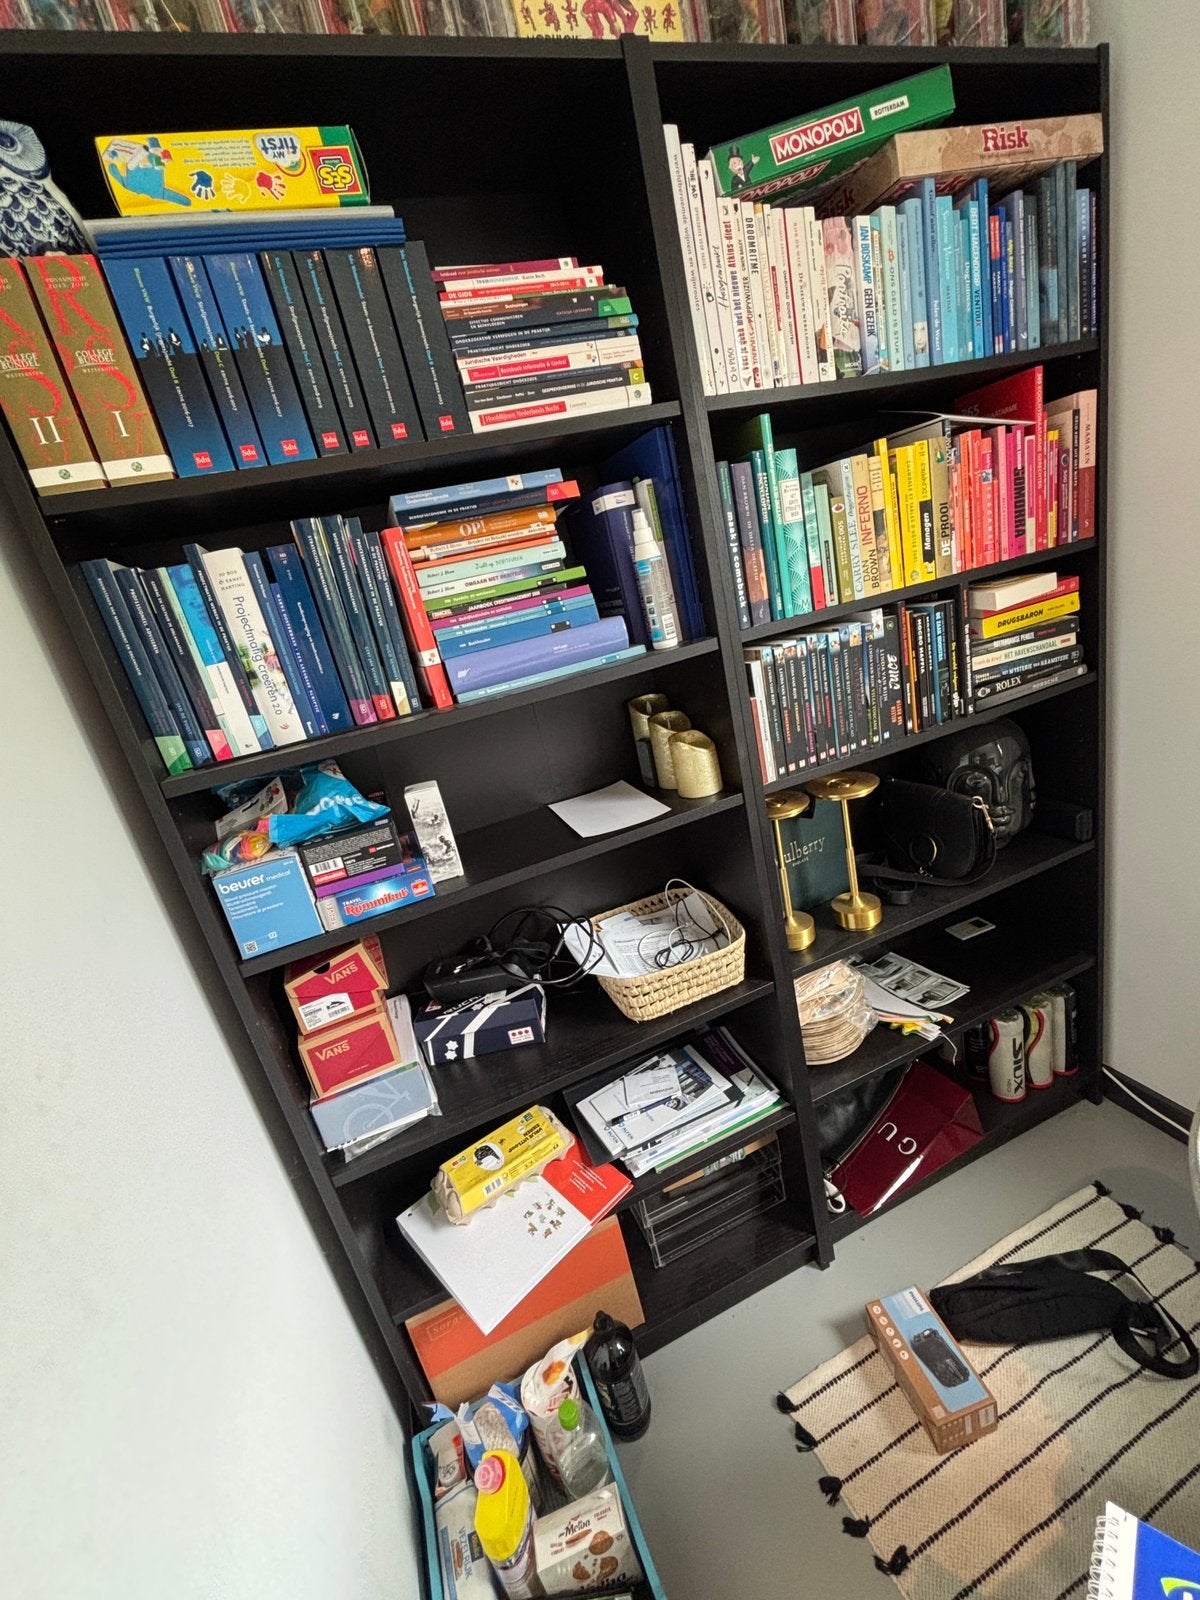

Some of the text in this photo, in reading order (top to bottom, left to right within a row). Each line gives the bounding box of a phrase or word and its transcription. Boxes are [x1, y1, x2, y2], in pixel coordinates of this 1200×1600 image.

[874, 100, 906, 117] ROTTERDAM
[260, 135, 297, 155] first
[774, 109, 860, 164] MONOPOLY
[982, 125, 1029, 152] Risk
[272, 150, 284, 158] MY
[318, 164, 352, 191] SES
[669, 154, 702, 311] wereldberoemde wijnen en wijnroutes
[744, 216, 759, 274] DROOMRITME
[858, 224, 872, 284] JAN BOSKAMP
[457, 290, 472, 298] GIDS
[974, 289, 982, 326] VENTOUX
[863, 287, 875, 337] GEEN GEZEIK
[892, 319, 897, 327] IS
[464, 350, 527, 366] Juridische Vaardigheden
[30, 416, 62, 445] II
[393, 426, 406, 435] Sdu
[440, 418, 452, 428] Sdu
[283, 443, 298, 452] Sdu
[324, 436, 338, 444] Sdu
[354, 434, 368, 442] Sdu
[196, 456, 211, 465] Sdu
[241, 449, 256, 458] Sdu
[742, 491, 750, 516] BROWN
[754, 473, 771, 524] ENCYCLOPEDIE
[760, 472, 773, 510] HONDEN
[1014, 467, 1026, 538] GOMORRA
[458, 519, 486, 537] OP!
[836, 520, 845, 535] 500
[854, 485, 874, 545] INFERNO
[939, 502, 950, 555] DE PROOI
[922, 512, 932, 549] Managen
[725, 511, 748, 607] maak je comeback
[746, 520, 752, 529] DE
[750, 553, 760, 580] DECEPTIE
[847, 519, 863, 592] CARRY SLEE
[306, 534, 333, 601] STRATEGISCH MANAGEMENT
[331, 532, 360, 614] MODERN MARKETINGMANAGEMENT
[860, 559, 871, 581] DAN
[867, 548, 880, 588] BROWN
[354, 538, 374, 590] PROCESMANAGEMENT
[373, 605, 384, 626] PRAKTIJK
[127, 587, 161, 654] PROFESSIONEEL ADVISEREN
[996, 609, 1044, 628] DRUGSBARON
[228, 594, 282, 716] Projectmatig creëren 2.0
[994, 676, 1022, 691] ROLEX
[783, 836, 825, 863] ulberry
[219, 870, 290, 894] beurer medical
[342, 897, 361, 906] TRAVEL
[344, 887, 408, 916] Rummikub
[324, 961, 358, 984] VANS
[315, 1040, 350, 1061] VANS
[1012, 1038, 1023, 1094] SIUX
[458, 1526, 472, 1580] VEZELRIJK
